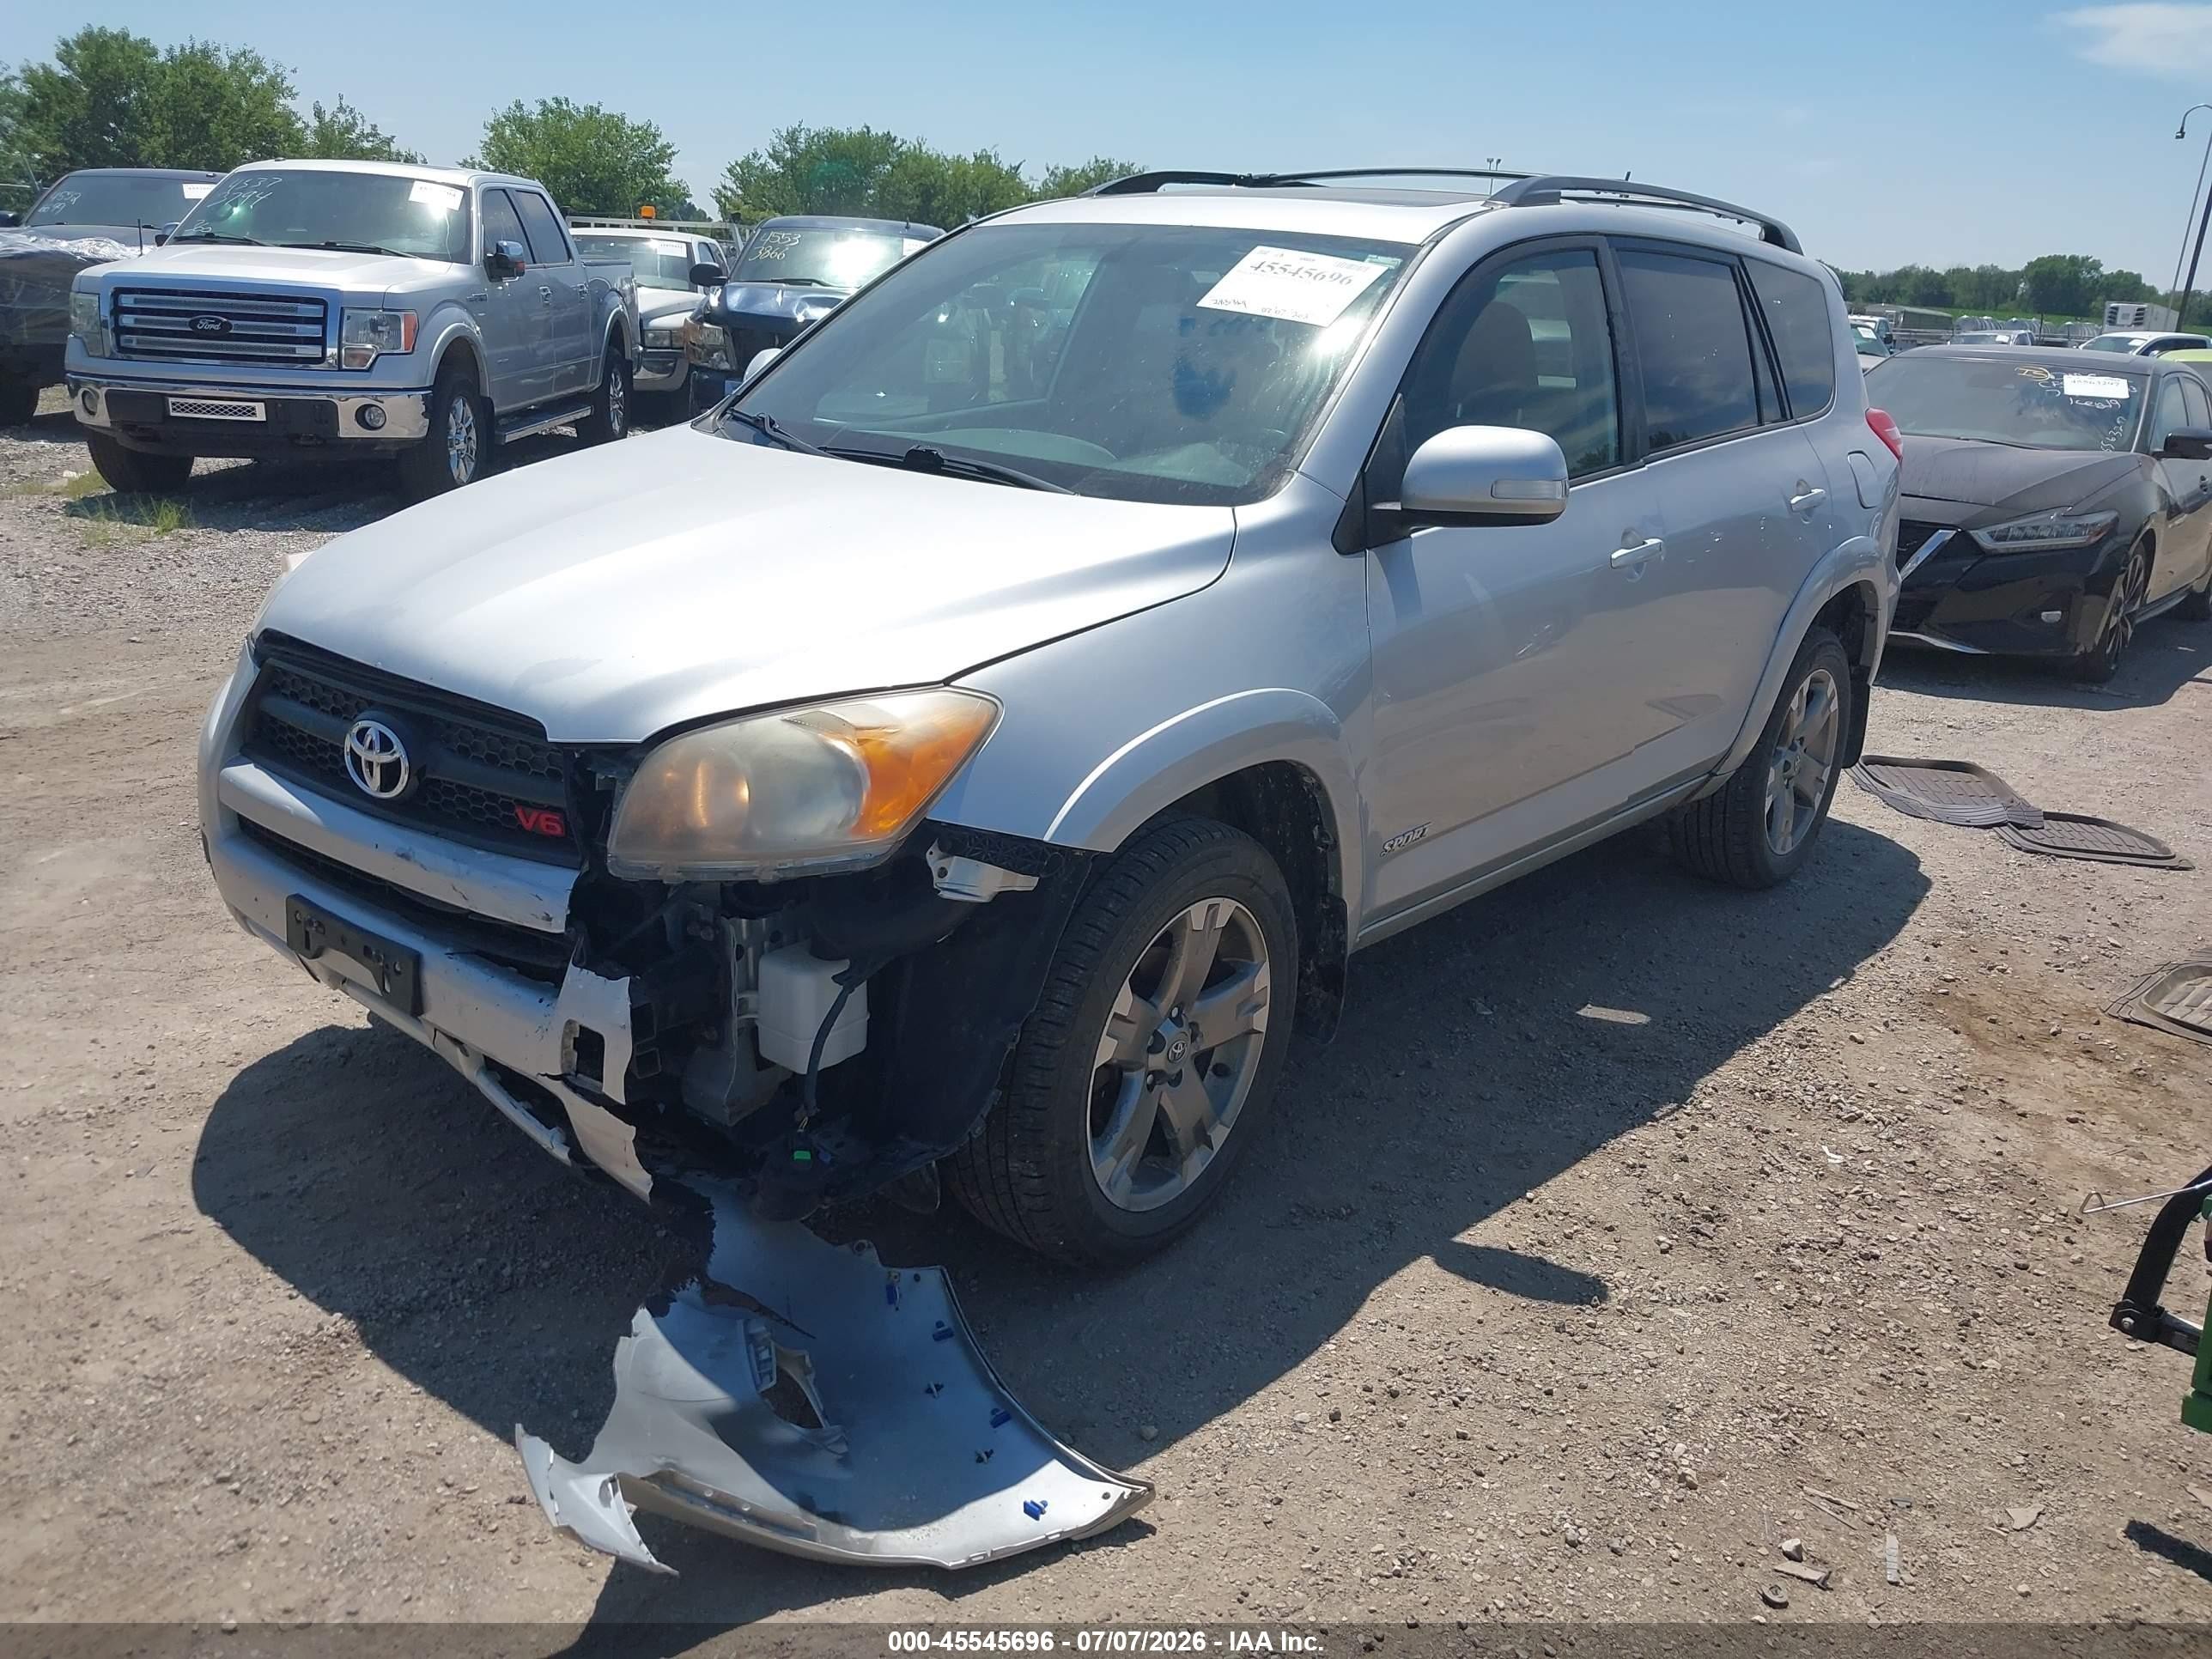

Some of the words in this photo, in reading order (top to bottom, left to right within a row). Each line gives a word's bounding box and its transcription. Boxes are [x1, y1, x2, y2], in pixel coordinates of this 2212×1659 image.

[760, 231, 801, 246] 4553
[748, 246, 789, 261] 3866
[1249, 260, 1353, 286] 45545696
[197, 319, 222, 331] Ford
[514, 805, 564, 837] V6
[1379, 821, 1434, 858] SPORT
